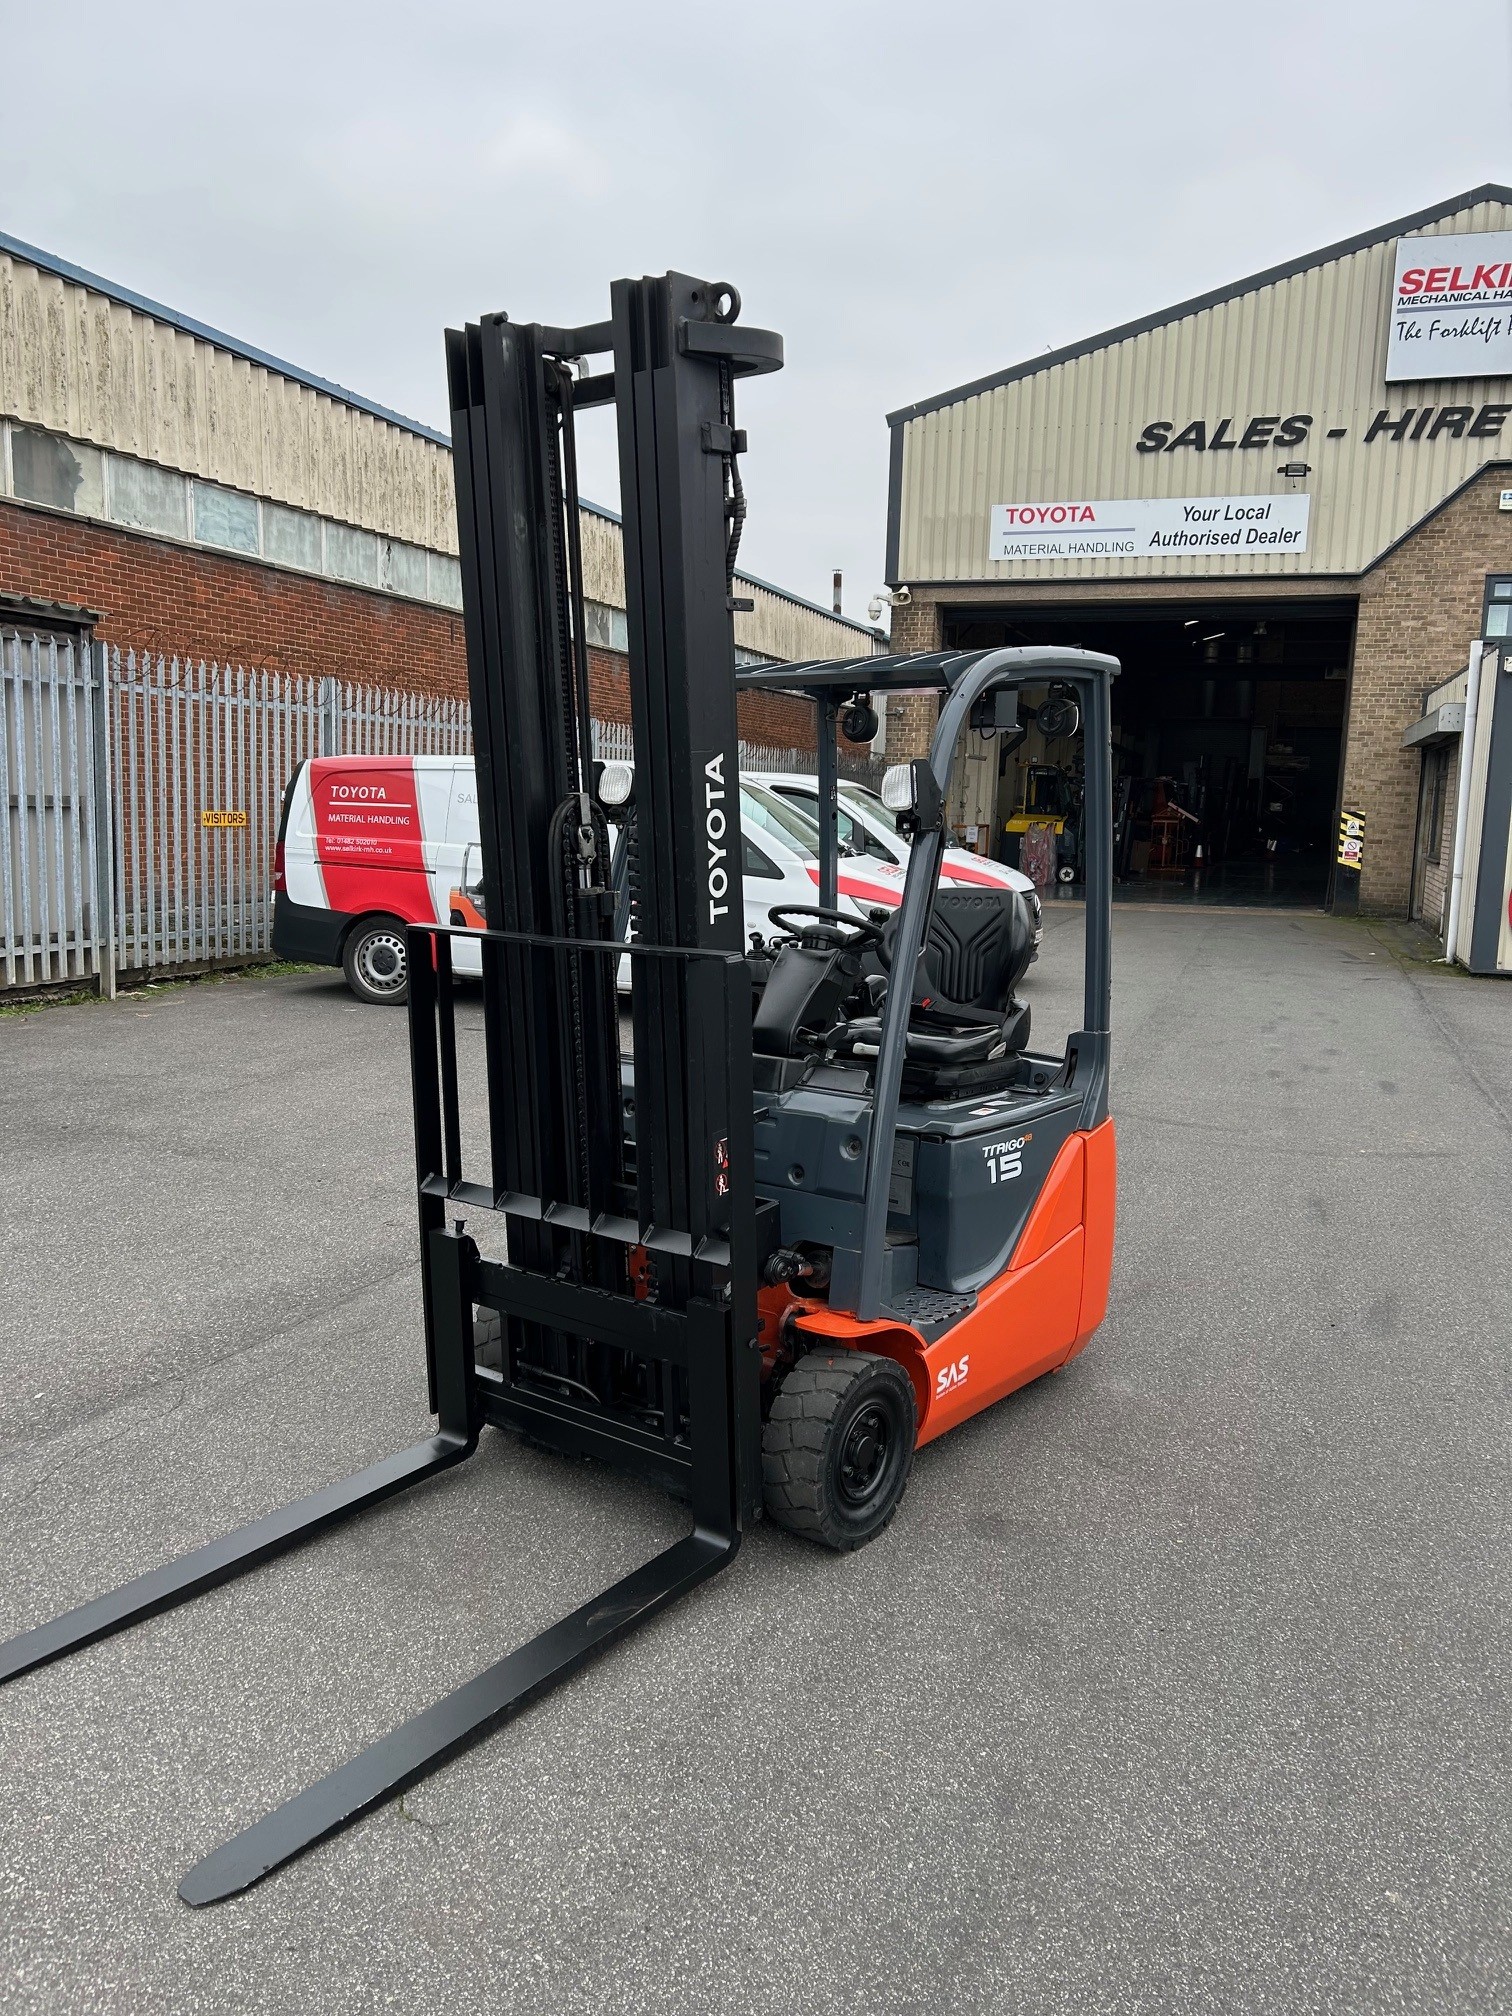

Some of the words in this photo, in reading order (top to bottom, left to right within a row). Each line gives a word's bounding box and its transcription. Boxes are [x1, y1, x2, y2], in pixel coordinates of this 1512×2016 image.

[1398, 263, 1512, 295] SELKI
[1397, 291, 1490, 306] MECHANICAL
[1397, 320, 1422, 341] The
[1429, 316, 1502, 343] Forklift
[1136, 414, 1314, 452] SALES
[1363, 404, 1512, 442] HIRE
[1005, 505, 1096, 525] TOYOTA
[1183, 505, 1221, 522] Your
[1223, 503, 1272, 521] Local
[1149, 528, 1242, 547] Authorised
[1245, 527, 1302, 545] Dealer
[1003, 543, 1065, 556] MATERIAL
[1068, 541, 1135, 554] HANDLING
[330, 785, 387, 800] TOYOTA
[205, 812, 244, 824] VISITORS
[328, 813, 366, 823] MATERIAL
[367, 815, 410, 825] HANDLING
[705, 752, 729, 925] TOYOTA
[324, 844, 393, 854] www.selkirk-mh.co.uk
[940, 895, 1002, 910] TOYOTA
[986, 1150, 1023, 1184] 15
[936, 1354, 970, 1394] SAS
